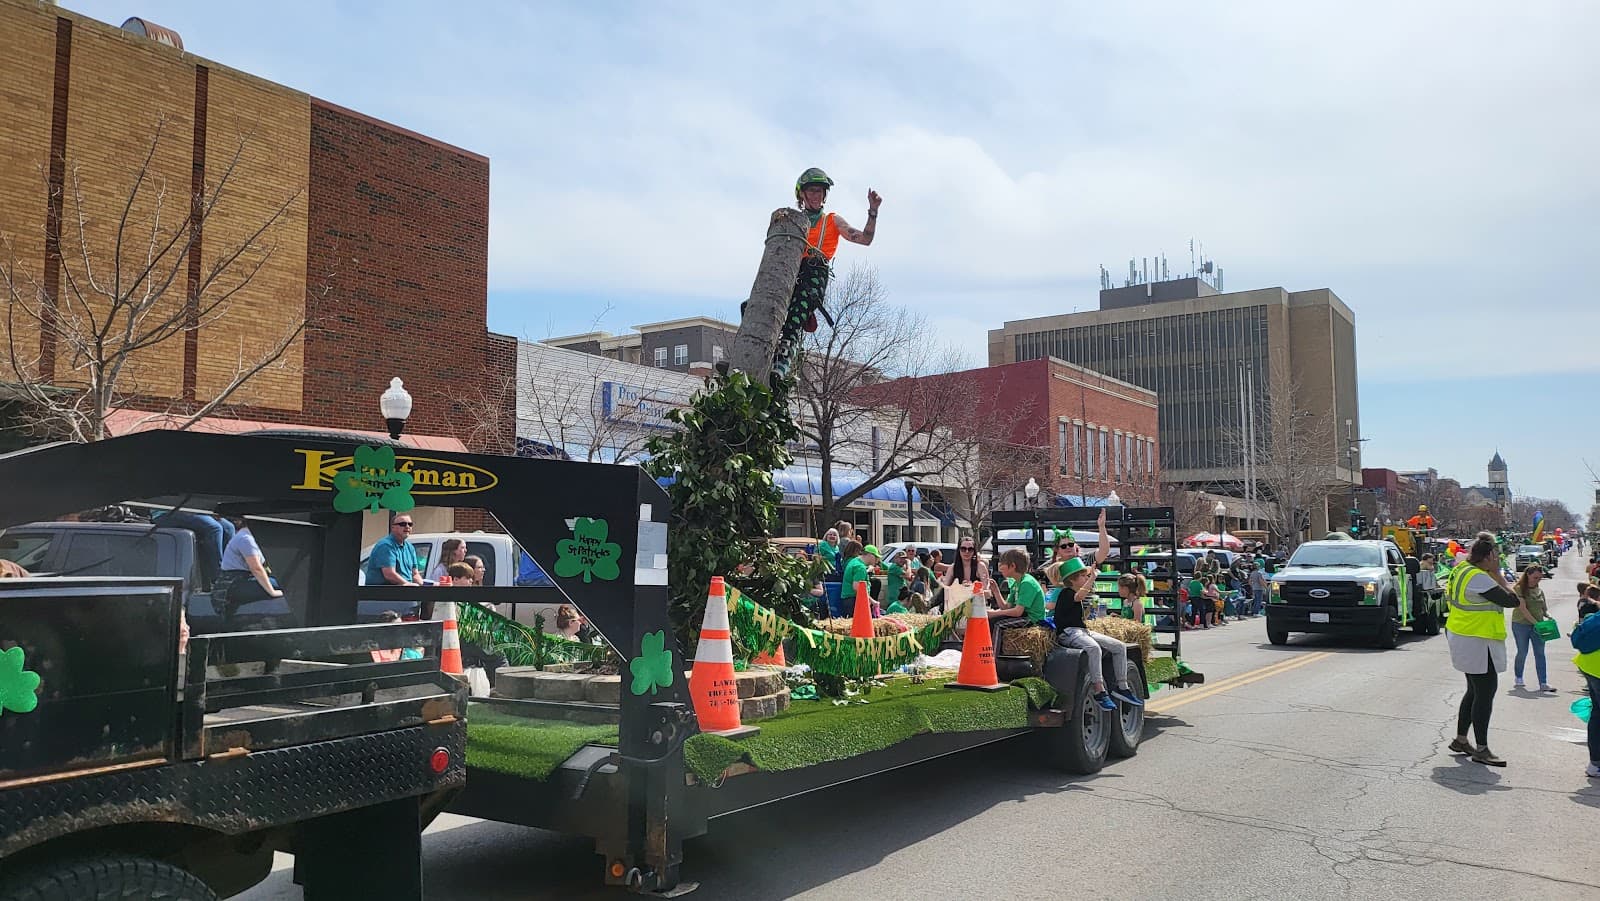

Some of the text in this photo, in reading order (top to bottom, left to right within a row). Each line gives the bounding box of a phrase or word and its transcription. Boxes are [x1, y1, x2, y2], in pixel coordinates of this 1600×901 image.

[291, 449, 478, 491] Kfman
[567, 544, 577, 556] St
[821, 636, 845, 658] ST
